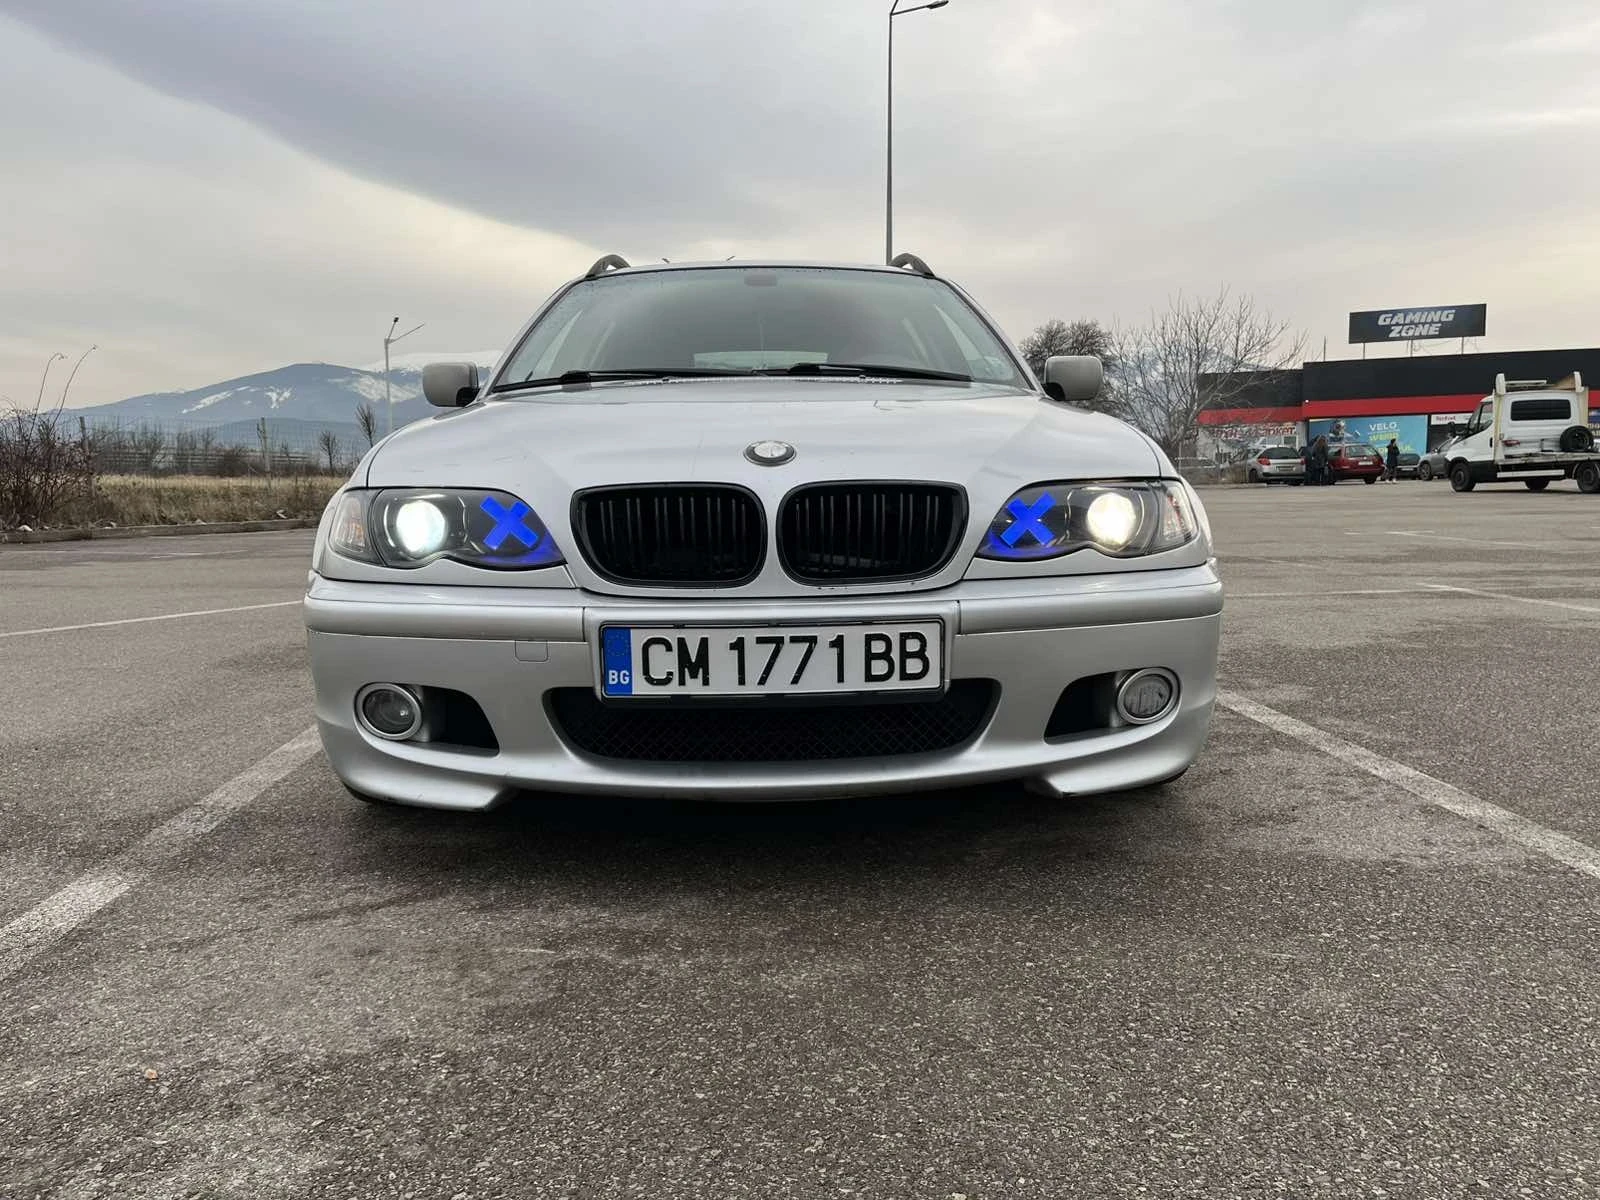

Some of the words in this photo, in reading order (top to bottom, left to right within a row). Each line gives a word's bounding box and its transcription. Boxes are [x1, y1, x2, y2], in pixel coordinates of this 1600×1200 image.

[1378, 310, 1456, 325] GAMING
[1388, 323, 1442, 338] ZONE
[1369, 422, 1397, 431] VELO
[641, 637, 709, 686] CM
[728, 635, 845, 686] 1771
[864, 632, 930, 682] BB
[608, 671, 630, 685] BG
